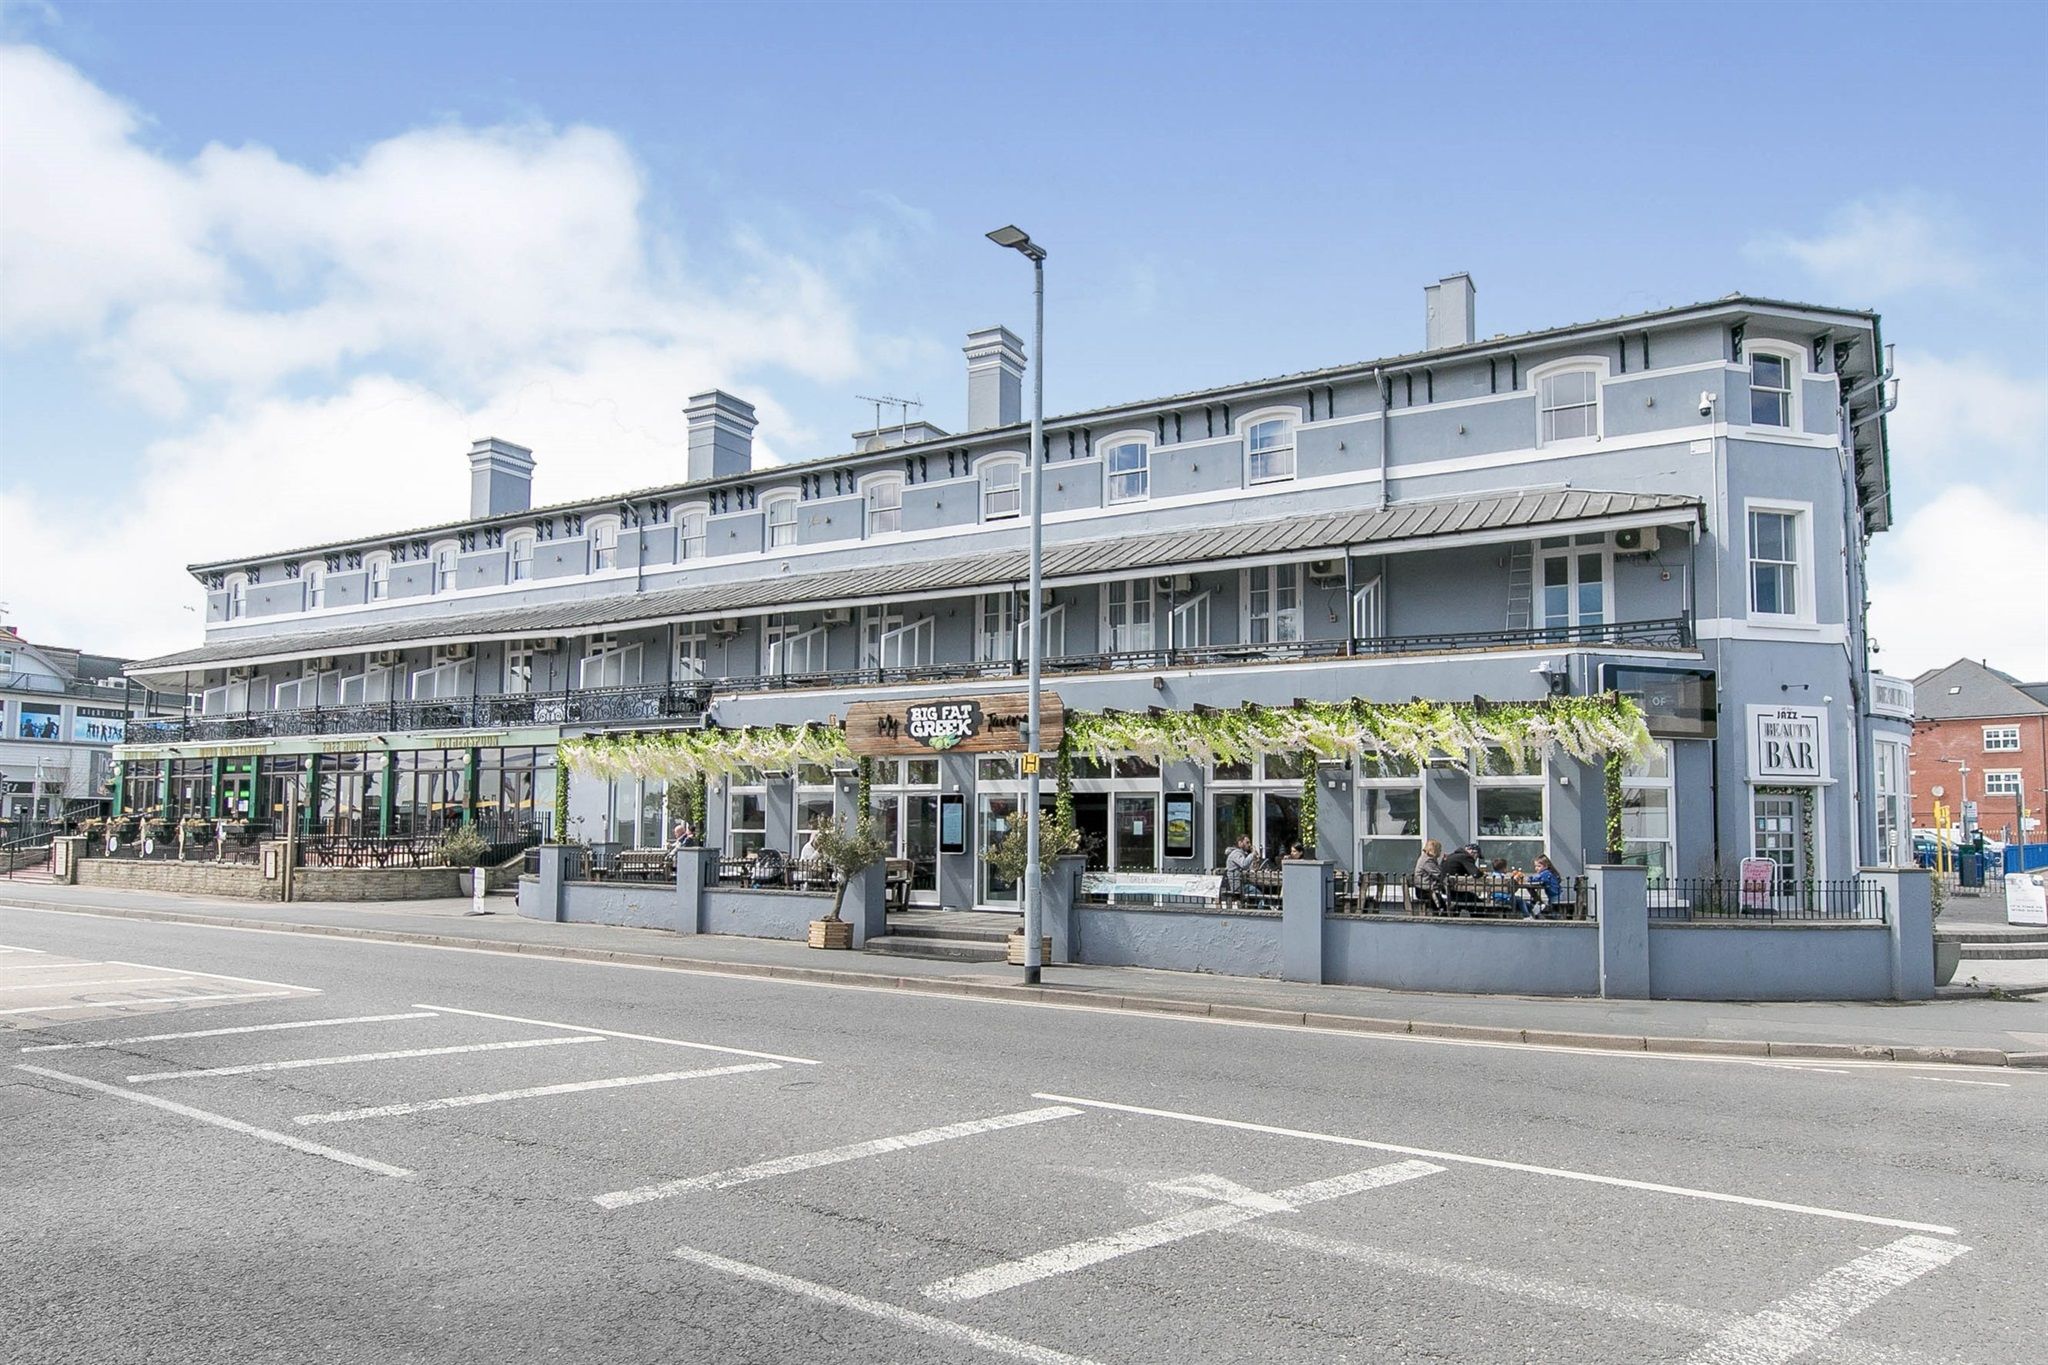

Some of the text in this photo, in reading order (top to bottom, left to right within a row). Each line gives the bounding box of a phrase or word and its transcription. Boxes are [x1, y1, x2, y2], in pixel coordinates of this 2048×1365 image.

[911, 707, 938, 720] BIG
[942, 705, 972, 719] FAT
[1777, 711, 1798, 719] JAZZ
[910, 719, 972, 737] GREEK
[1764, 722, 1812, 737] BEAUTY
[434, 735, 499, 749] WETHERSPOON
[1764, 740, 1815, 769] BAR
[1025, 755, 1037, 771] H
